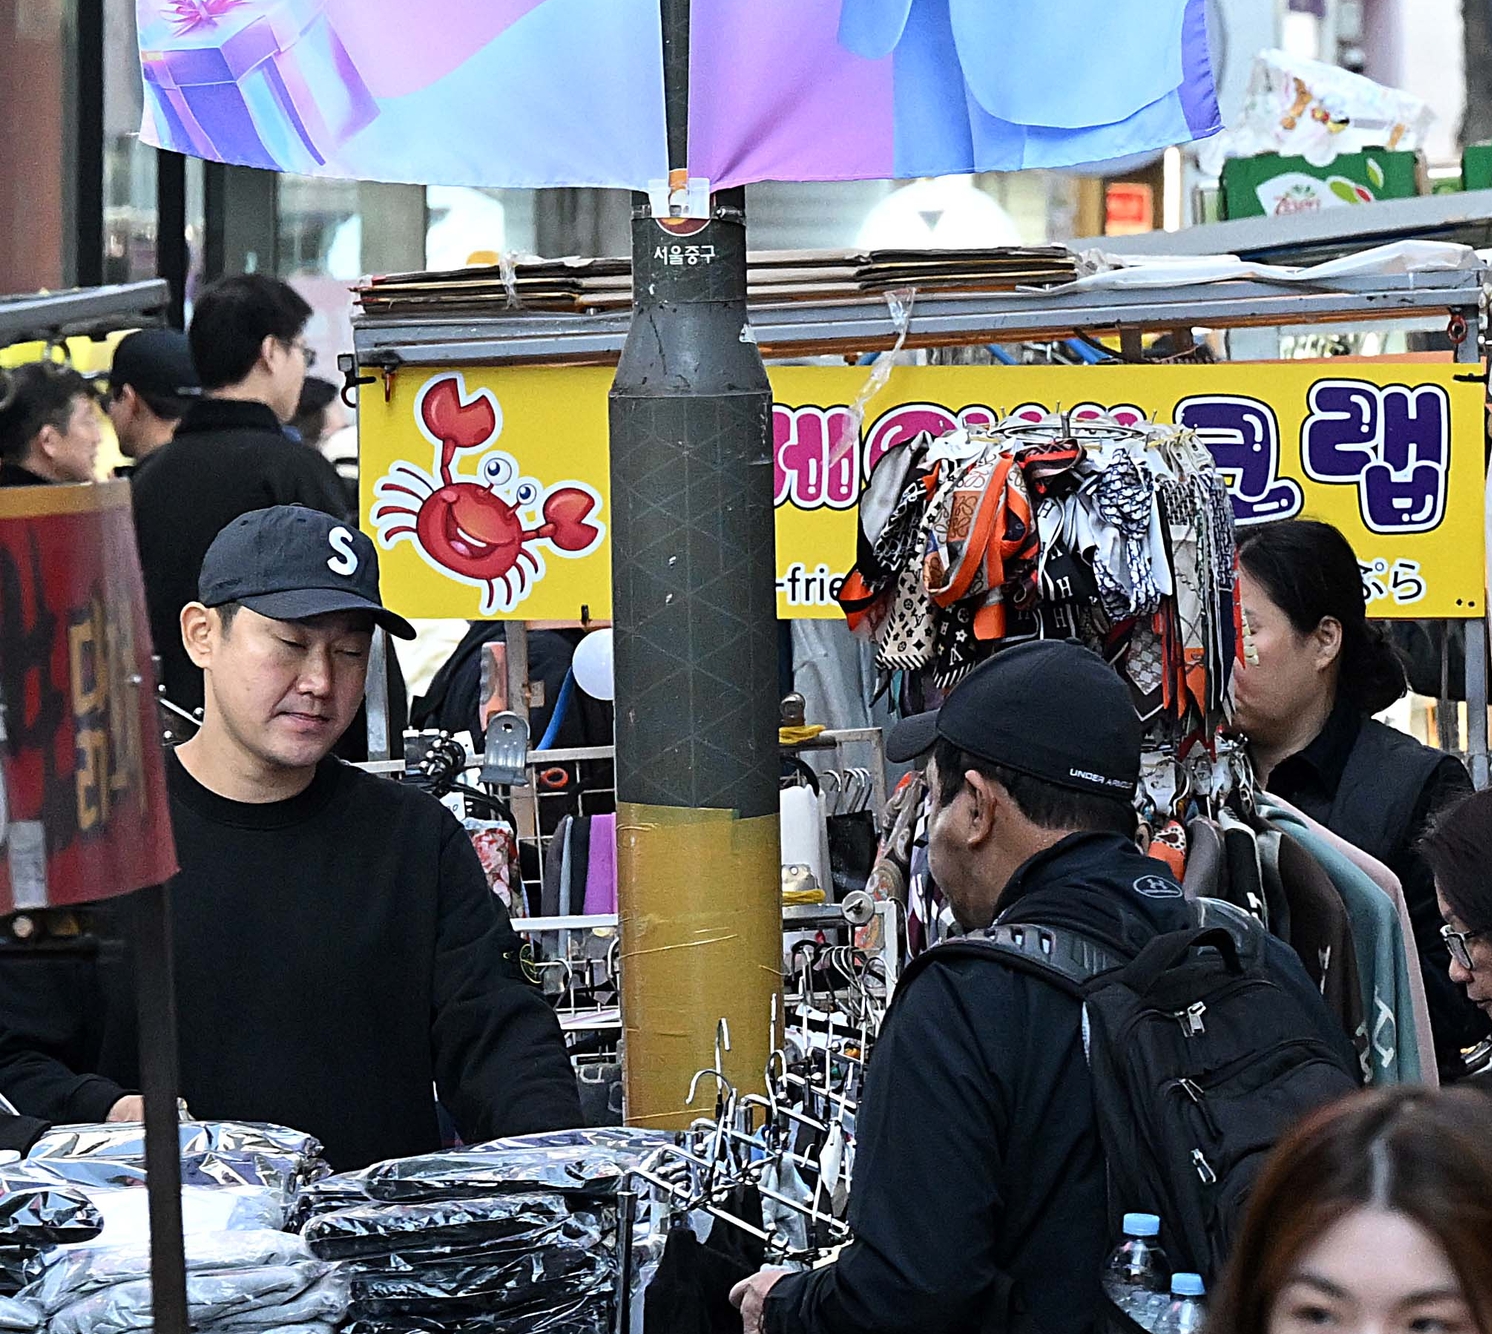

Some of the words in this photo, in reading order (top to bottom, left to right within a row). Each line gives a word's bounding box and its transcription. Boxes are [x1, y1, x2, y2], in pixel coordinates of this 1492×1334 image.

[654, 245, 716, 265] 서울중구
[328, 526, 358, 575] S
[1069, 768, 1105, 784] UNDER
